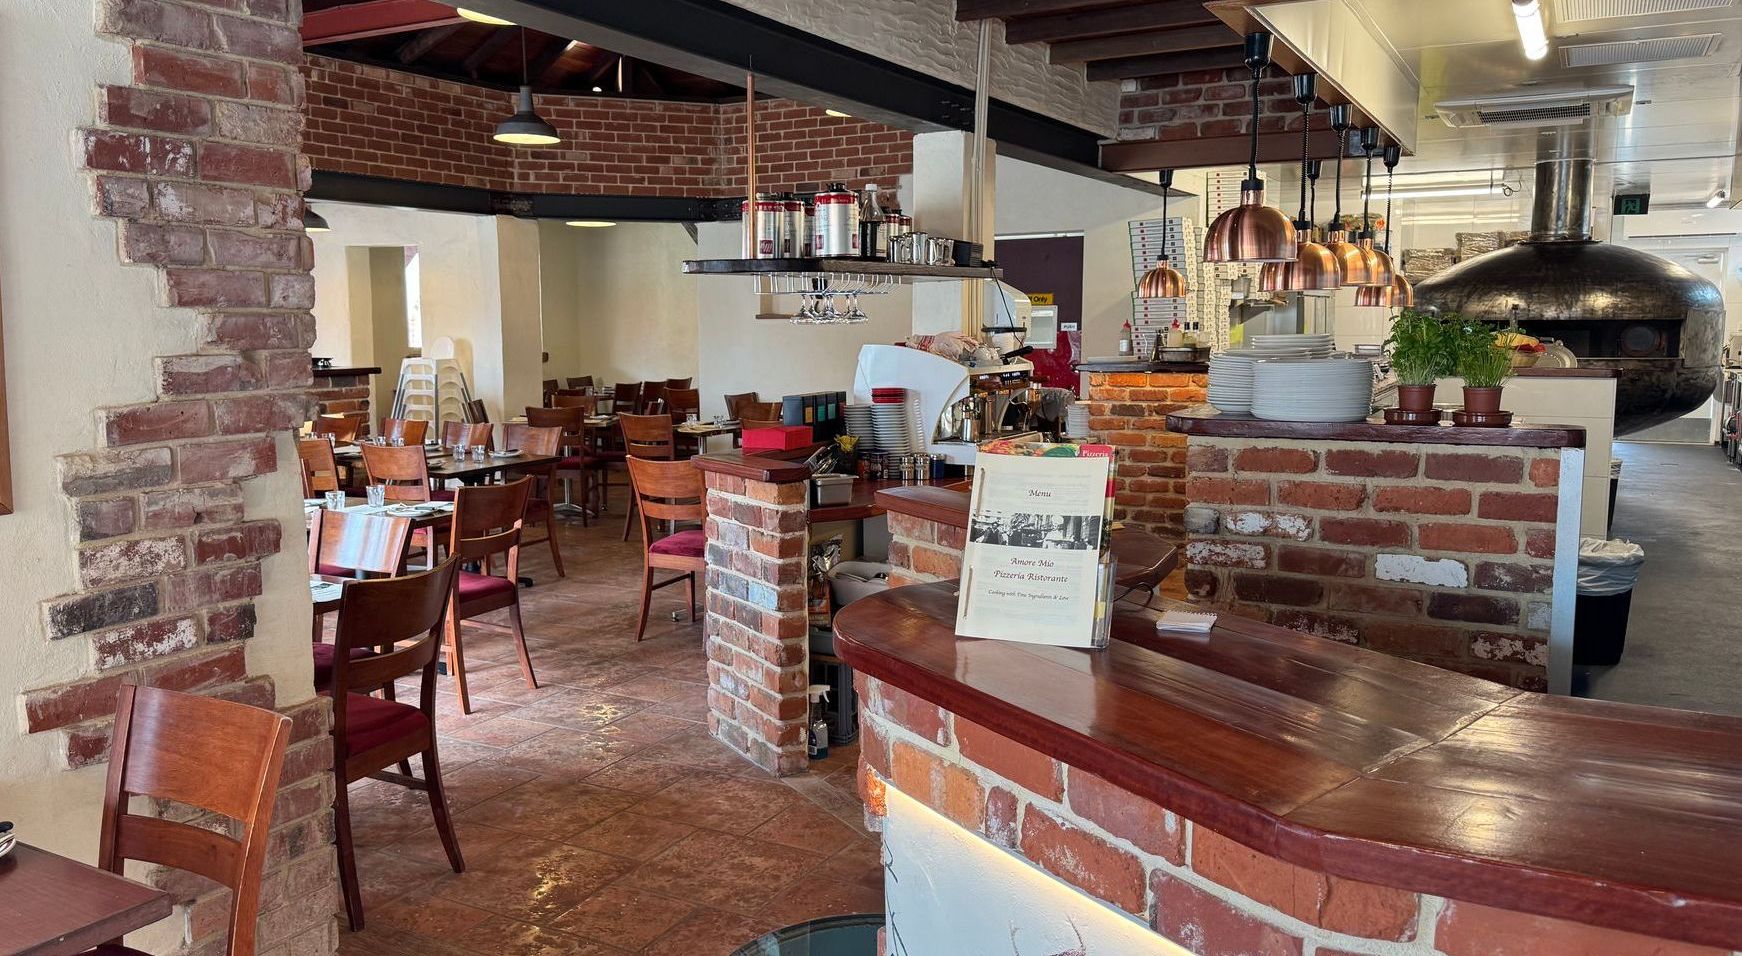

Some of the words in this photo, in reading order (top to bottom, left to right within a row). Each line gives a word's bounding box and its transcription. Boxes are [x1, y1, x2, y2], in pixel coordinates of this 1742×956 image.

[1028, 489, 1052, 498] Menu
[1010, 557, 1036, 567] Amore
[1037, 559, 1055, 568] Mio
[993, 570, 1025, 580] Pizzeria
[1026, 574, 1069, 583] Ristorante
[988, 589, 1006, 597] Cooking
